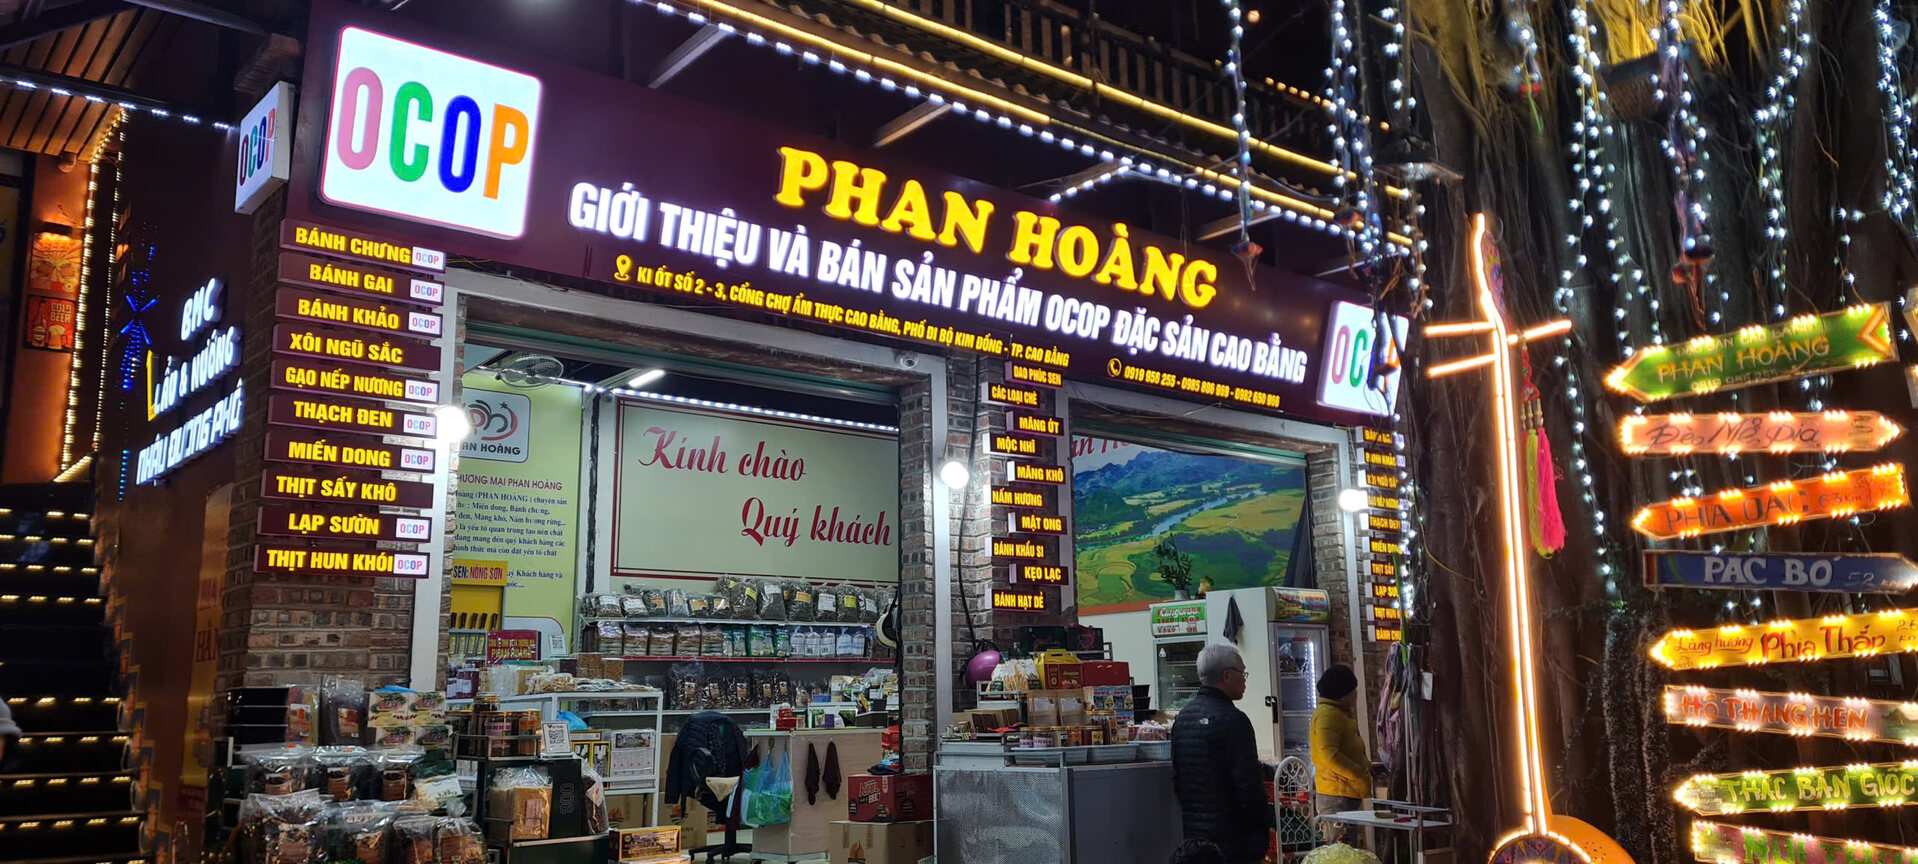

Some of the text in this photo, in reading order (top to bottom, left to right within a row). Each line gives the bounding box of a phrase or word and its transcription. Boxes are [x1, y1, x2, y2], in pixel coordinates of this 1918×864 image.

[336, 66, 529, 200] OCOP
[239, 107, 276, 186] OCOP
[774, 146, 1218, 308] PHAN HOÀNG
[295, 227, 411, 264] BÁNH CHƯNG
[415, 252, 440, 265] OCOP
[309, 264, 394, 293] BÁNH GAI
[568, 182, 1308, 384] GIỚI THIỆU VÀ BÁN SẢN PHẨM OCOP ĐẶC SẢN CAO BẰNG
[414, 284, 438, 297] OCOP
[50, 312, 71, 323] BEER
[181, 277, 219, 341] BMC
[298, 298, 399, 329] BÁNH KHẢO
[637, 266, 653, 283] KI
[654, 265, 674, 288] ỐT
[674, 271, 695, 292] SỐ
[694, 278, 704, 294] 2
[715, 282, 727, 301] 3,
[730, 282, 764, 306] CỔNG
[766, 292, 791, 314] CHỢ
[815, 303, 844, 323] THỰC
[845, 308, 868, 327] CAO
[903, 319, 926, 338] PHỐ
[926, 326, 938, 341] ĐI
[938, 327, 954, 347] BỘ
[954, 331, 975, 348] KIM
[975, 333, 1003, 354] ĐỒNG
[1025, 346, 1044, 362] CAO
[1044, 346, 1070, 367] BẰNG
[412, 317, 436, 330] OCOP
[290, 331, 403, 364] XÔI NGŨ SẮC
[1656, 353, 1725, 384] PHAN
[1736, 335, 1831, 371] HOÀNG
[285, 367, 403, 397] GẠO NẾP NƯƠNG
[1047, 373, 1062, 385] SEN
[1124, 365, 1145, 382] 0919
[408, 385, 433, 397] OCOP
[991, 384, 1037, 405] CÁC LOẠI CHÈ
[294, 401, 393, 428] THẠCH ĐEN
[407, 419, 431, 431] OCOP
[1019, 416, 1060, 433] MĂNG ỚT
[288, 439, 391, 467] MIẾN DONG
[480, 443, 521, 455] HOÀNG
[638, 426, 807, 481] Kính chào
[996, 436, 1036, 453] MỘC NHĨ
[404, 454, 429, 466] OCOP
[508, 478, 530, 489] PHAN
[532, 478, 562, 490] HOÀNG
[1017, 465, 1064, 482] MĂNG KHÔ
[276, 475, 396, 502] THỊT SẤY KHÔ
[992, 488, 1043, 507] NẤM HƯƠNG
[288, 513, 380, 535] LẠP SƯỜN
[741, 497, 893, 547] Quý khách
[1021, 514, 1062, 531] MẬT ONG
[1666, 504, 1733, 531] PHIA
[400, 523, 425, 535] OCOP
[993, 541, 1015, 556] BÁNH
[267, 550, 393, 572] THỊT HUN KHÓI
[397, 559, 423, 571] OCOP
[1024, 566, 1061, 582] KẸO LẠC
[994, 592, 1015, 607] BÁNH
[1017, 594, 1033, 611] HẠT
[1722, 696, 1808, 728] THANG
[1813, 705, 1869, 729] HEN
